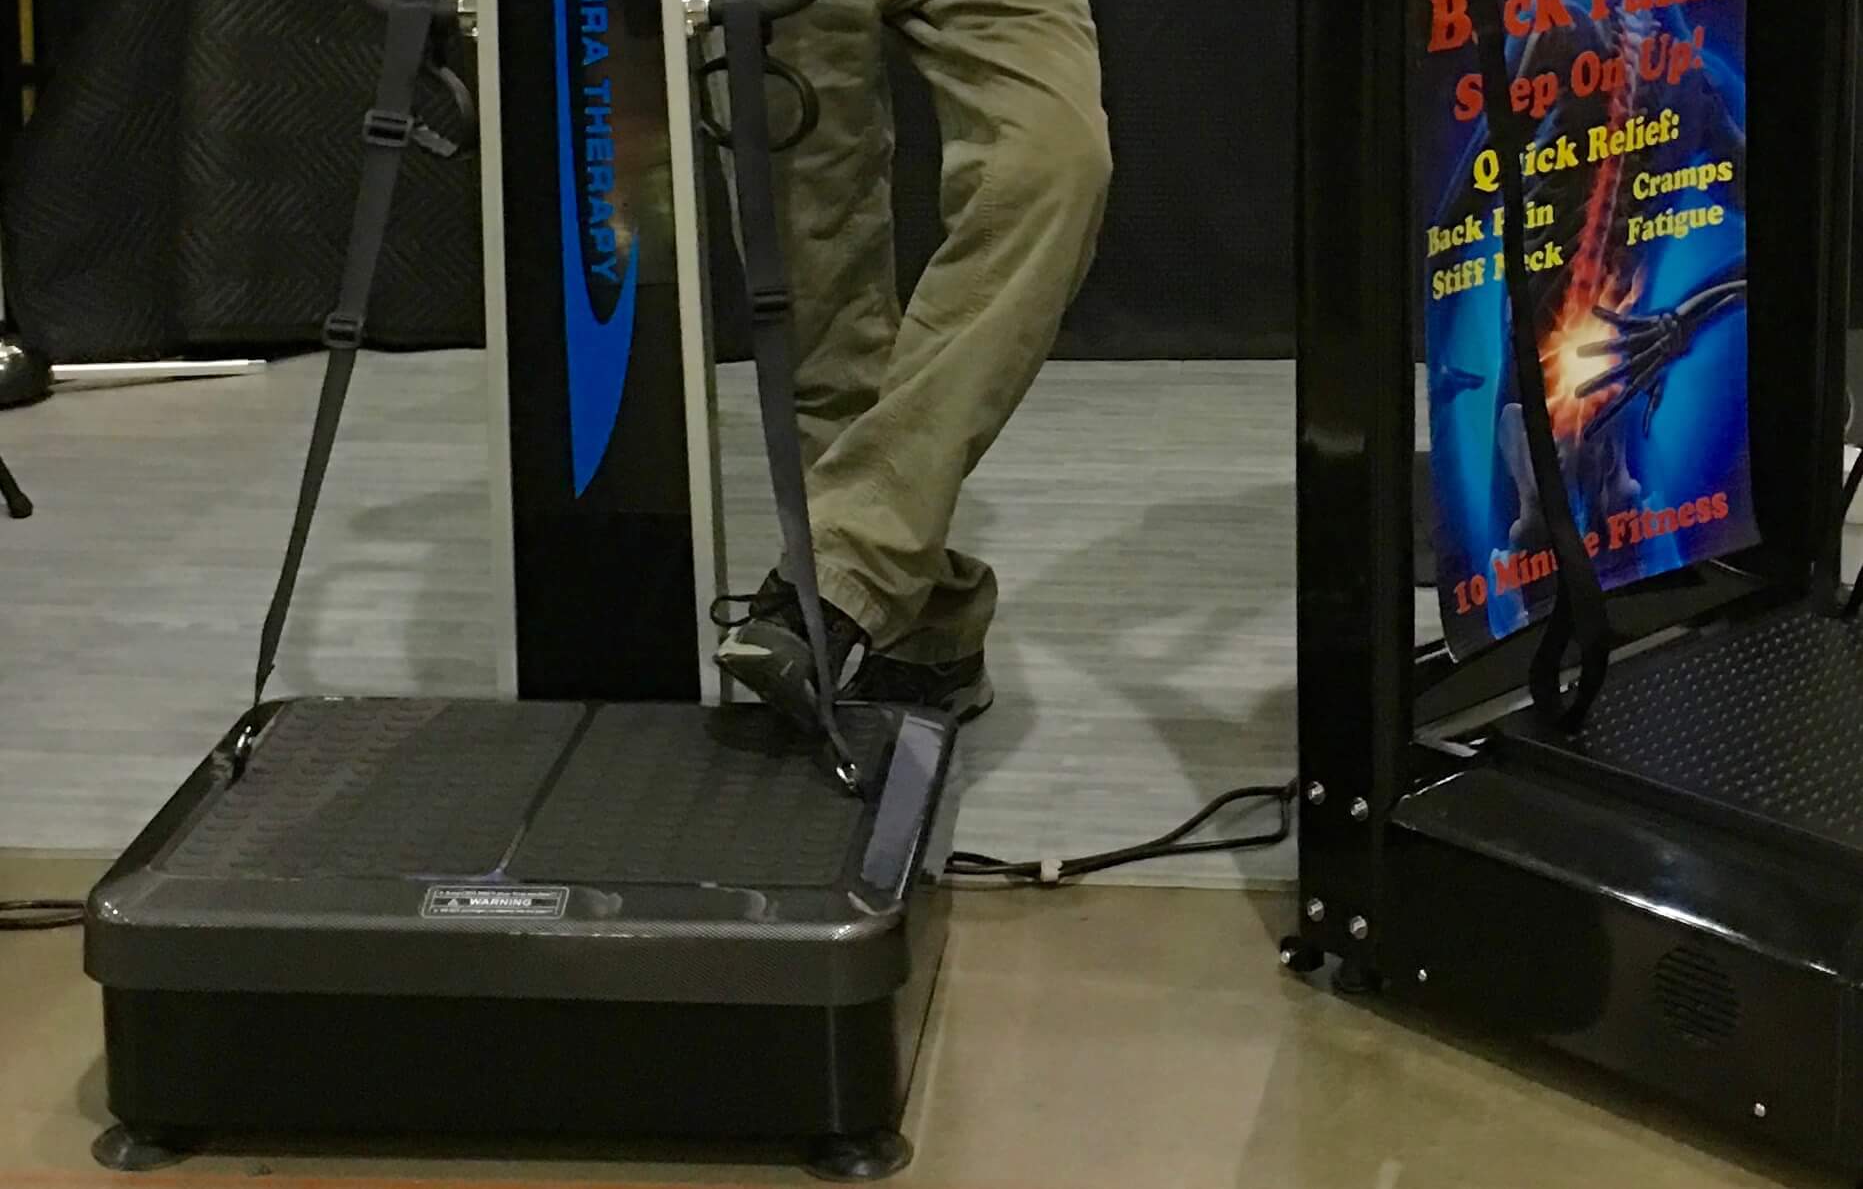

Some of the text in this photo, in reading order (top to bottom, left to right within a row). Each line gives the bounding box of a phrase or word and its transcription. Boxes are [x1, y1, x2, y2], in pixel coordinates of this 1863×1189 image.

[1454, 26, 1705, 123] Sep On Up!
[1473, 108, 1681, 193] Qick Relief:
[583, 77, 620, 284] THERAPY
[1632, 161, 1734, 201] Cramps
[1427, 214, 1485, 259] Back
[1626, 203, 1725, 246] Fatigue
[1432, 257, 1486, 301] Stiff
[1454, 491, 1729, 615] 10 Mine Fitness
[469, 898, 532, 907] WARNING
